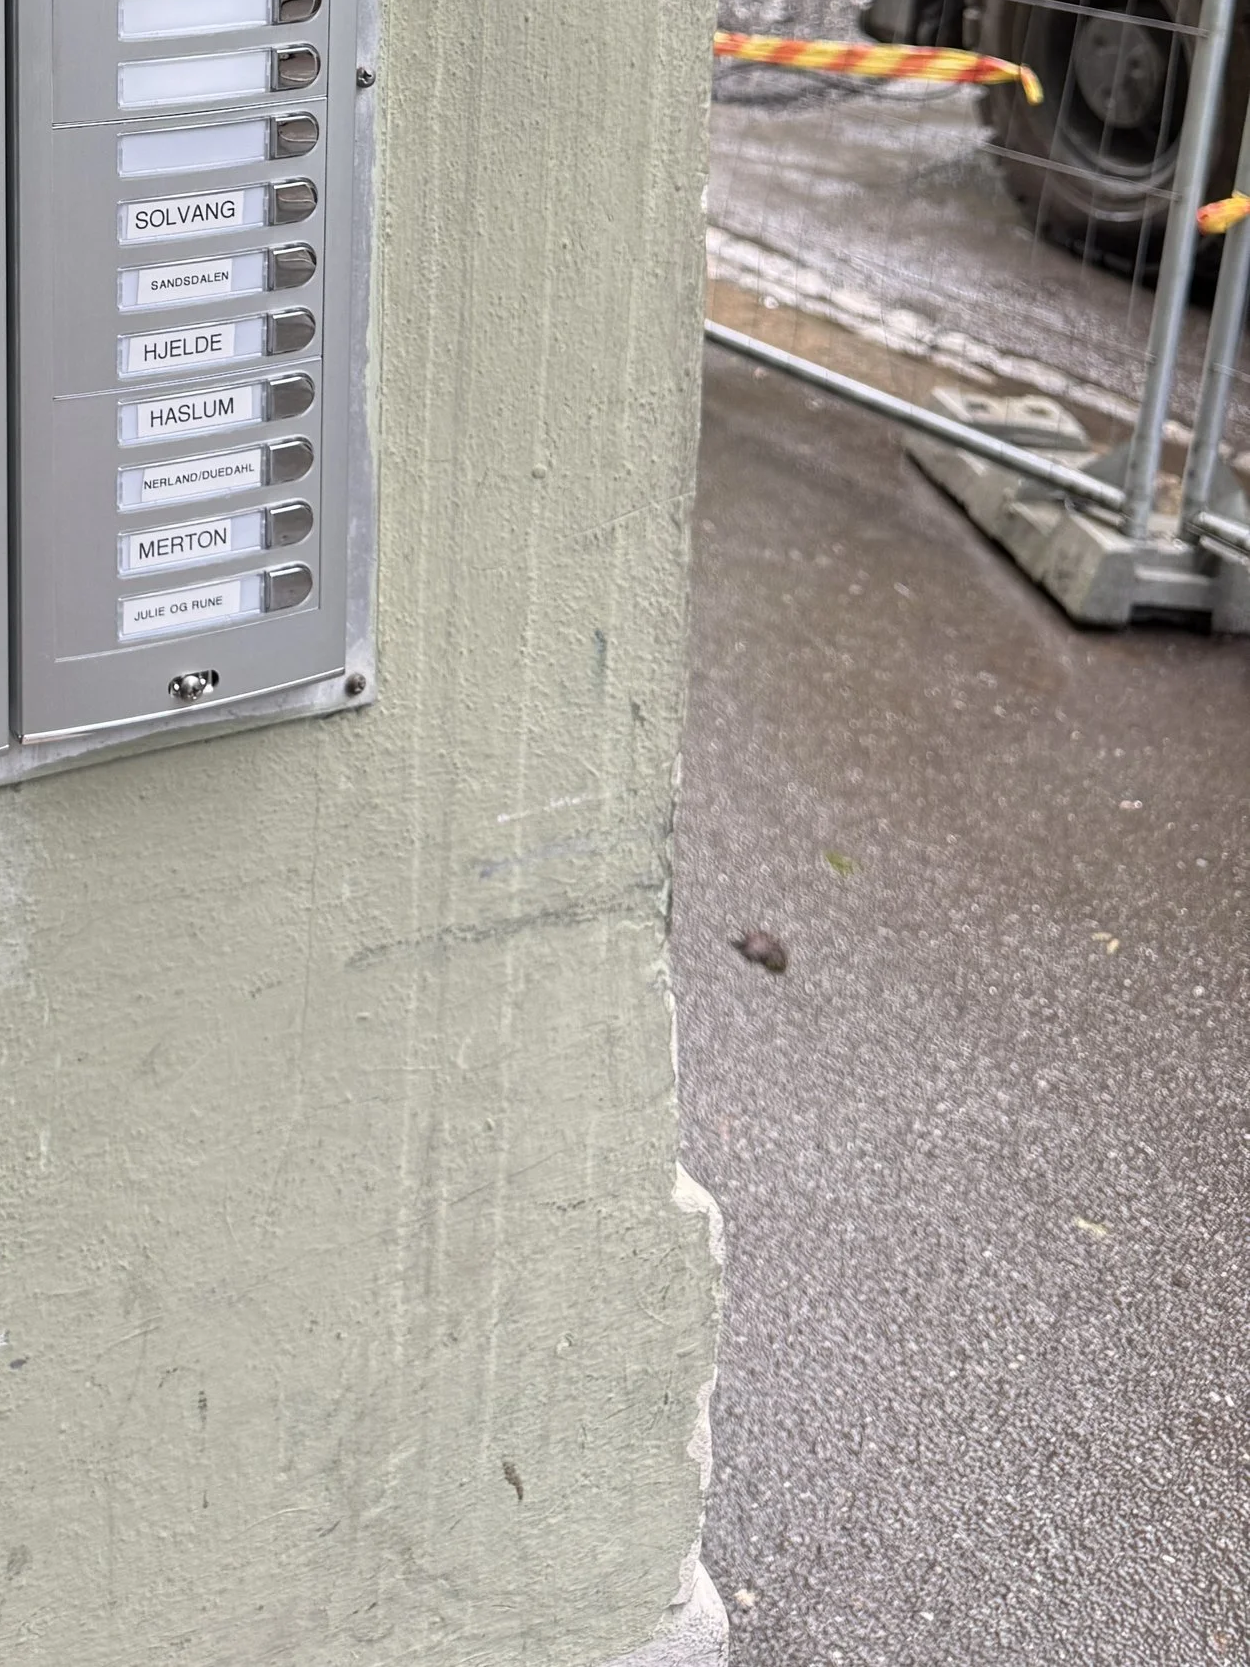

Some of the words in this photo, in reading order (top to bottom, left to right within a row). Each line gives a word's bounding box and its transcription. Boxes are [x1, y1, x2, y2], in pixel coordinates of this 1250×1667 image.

[135, 200, 236, 230] SOLVANG
[150, 271, 230, 291] SANDSDALEN
[143, 334, 222, 362] HJELDE
[149, 397, 235, 428] HASLUM
[143, 463, 255, 490] NERLAND/DUEDAHL
[138, 527, 227, 560] MERTON
[133, 606, 166, 623] JULIE
[169, 601, 188, 614] OG
[191, 595, 223, 611] RUNE
